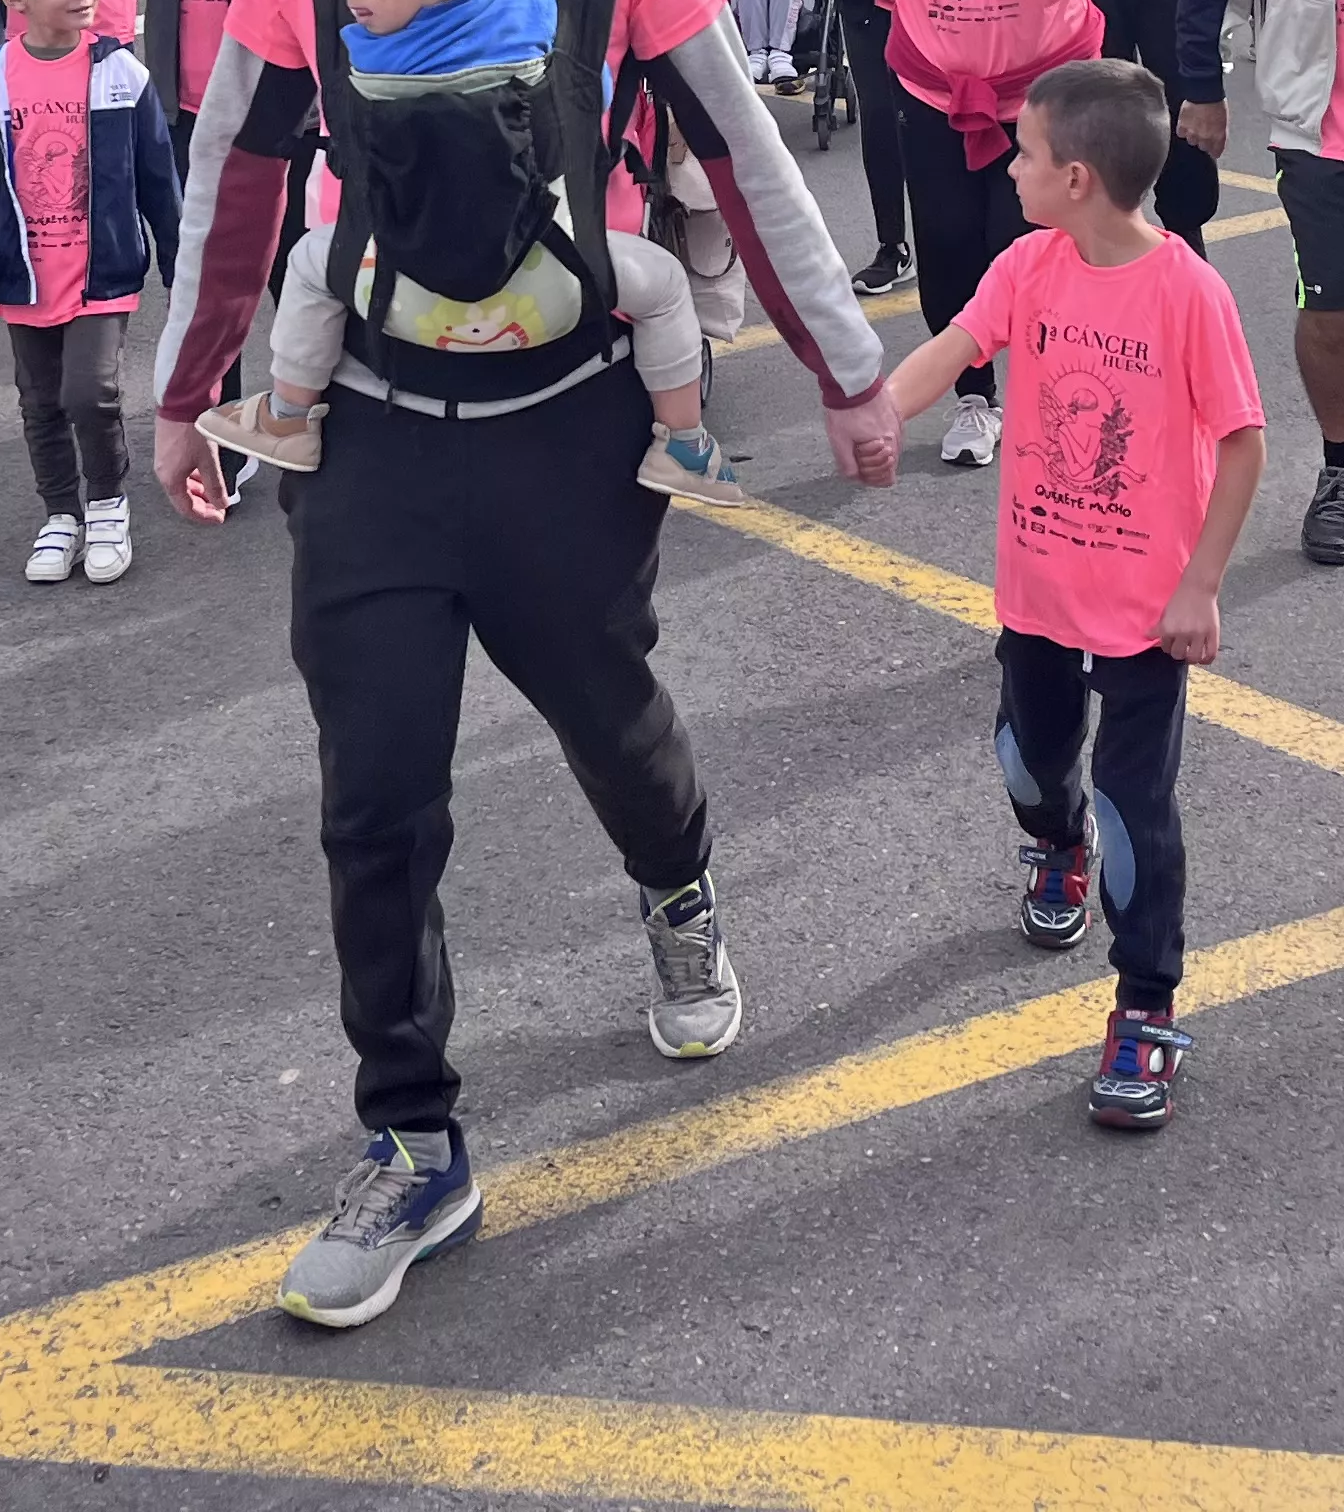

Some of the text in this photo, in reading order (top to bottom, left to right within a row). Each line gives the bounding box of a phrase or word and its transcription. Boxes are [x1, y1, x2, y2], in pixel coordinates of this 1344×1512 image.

[31, 98, 86, 115] CÁNCE
[1063, 324, 1149, 361] CÁNCER
[1102, 354, 1163, 379] HUESCA
